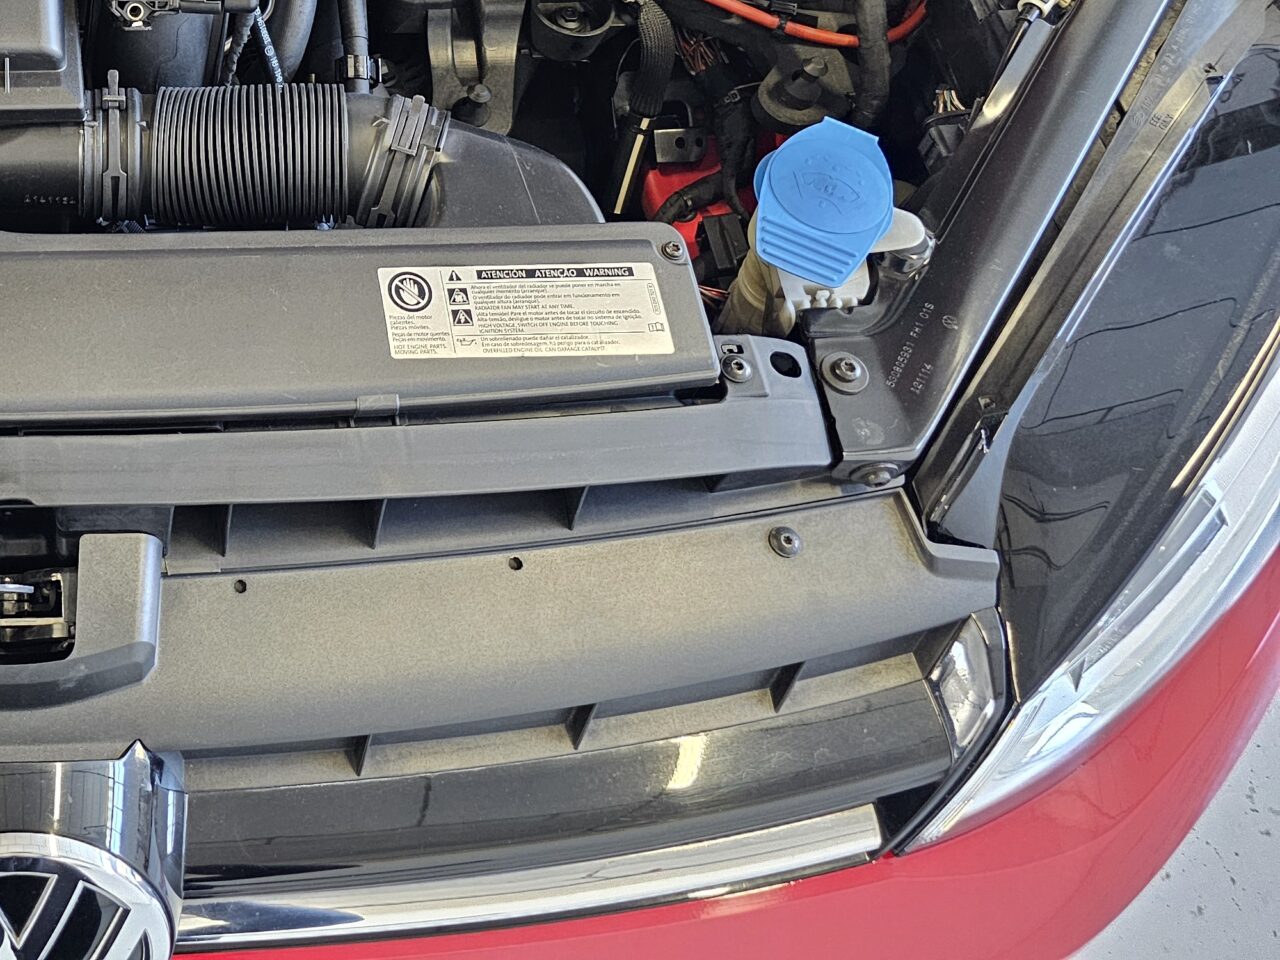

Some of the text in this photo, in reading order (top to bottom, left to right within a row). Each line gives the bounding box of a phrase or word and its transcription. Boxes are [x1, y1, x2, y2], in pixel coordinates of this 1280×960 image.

[481, 267, 629, 279] ATENCIÓN ATENÇÃO WARNING
